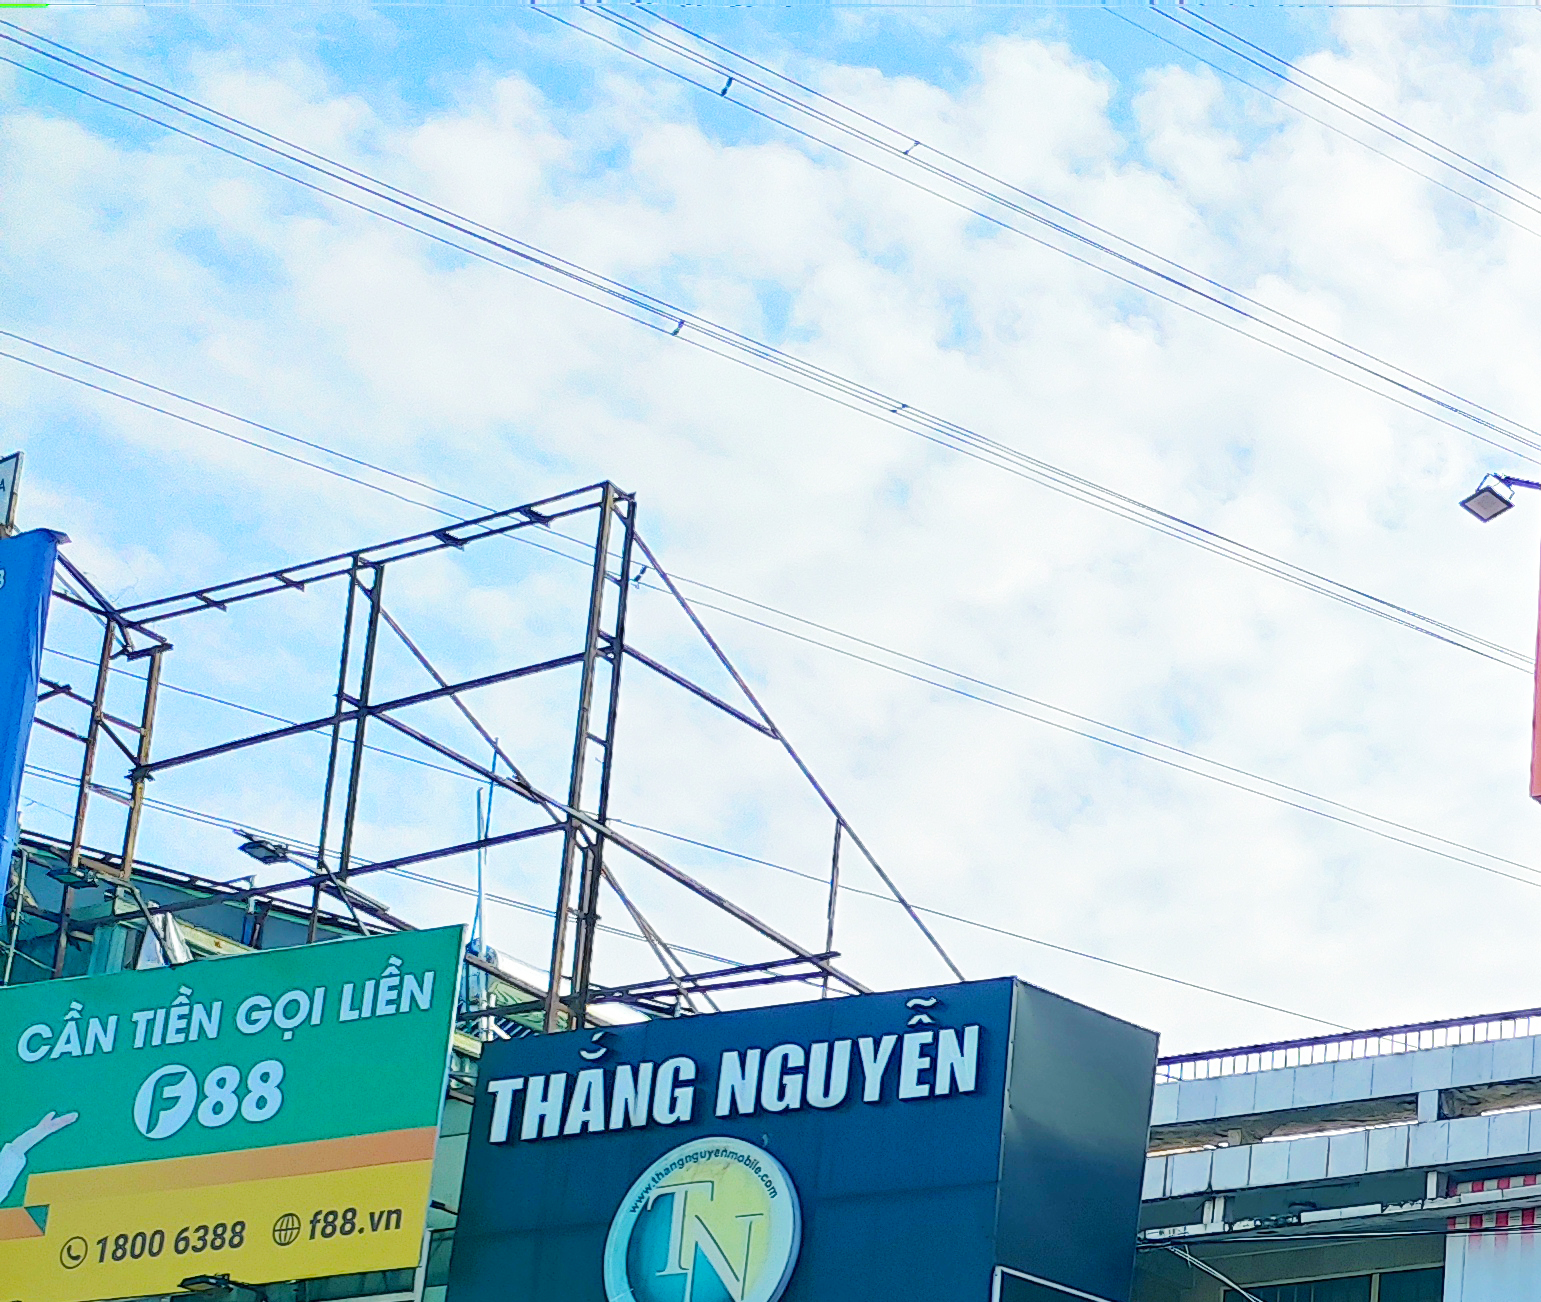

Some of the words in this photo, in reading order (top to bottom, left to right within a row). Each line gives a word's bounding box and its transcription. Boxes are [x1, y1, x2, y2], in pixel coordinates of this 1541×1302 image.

[17, 1001, 117, 1062] CẦN
[132, 986, 223, 1049] TIỀN
[236, 987, 325, 1040] GỌI
[339, 955, 434, 1022] LIỀN
[133, 1059, 284, 1139] F88
[487, 1034, 697, 1145] THẮNG
[714, 996, 982, 1118] NGUYỄN
[96, 1229, 164, 1263] 1800
[173, 1220, 246, 1255] 6388
[308, 1207, 402, 1241] f88.vn
